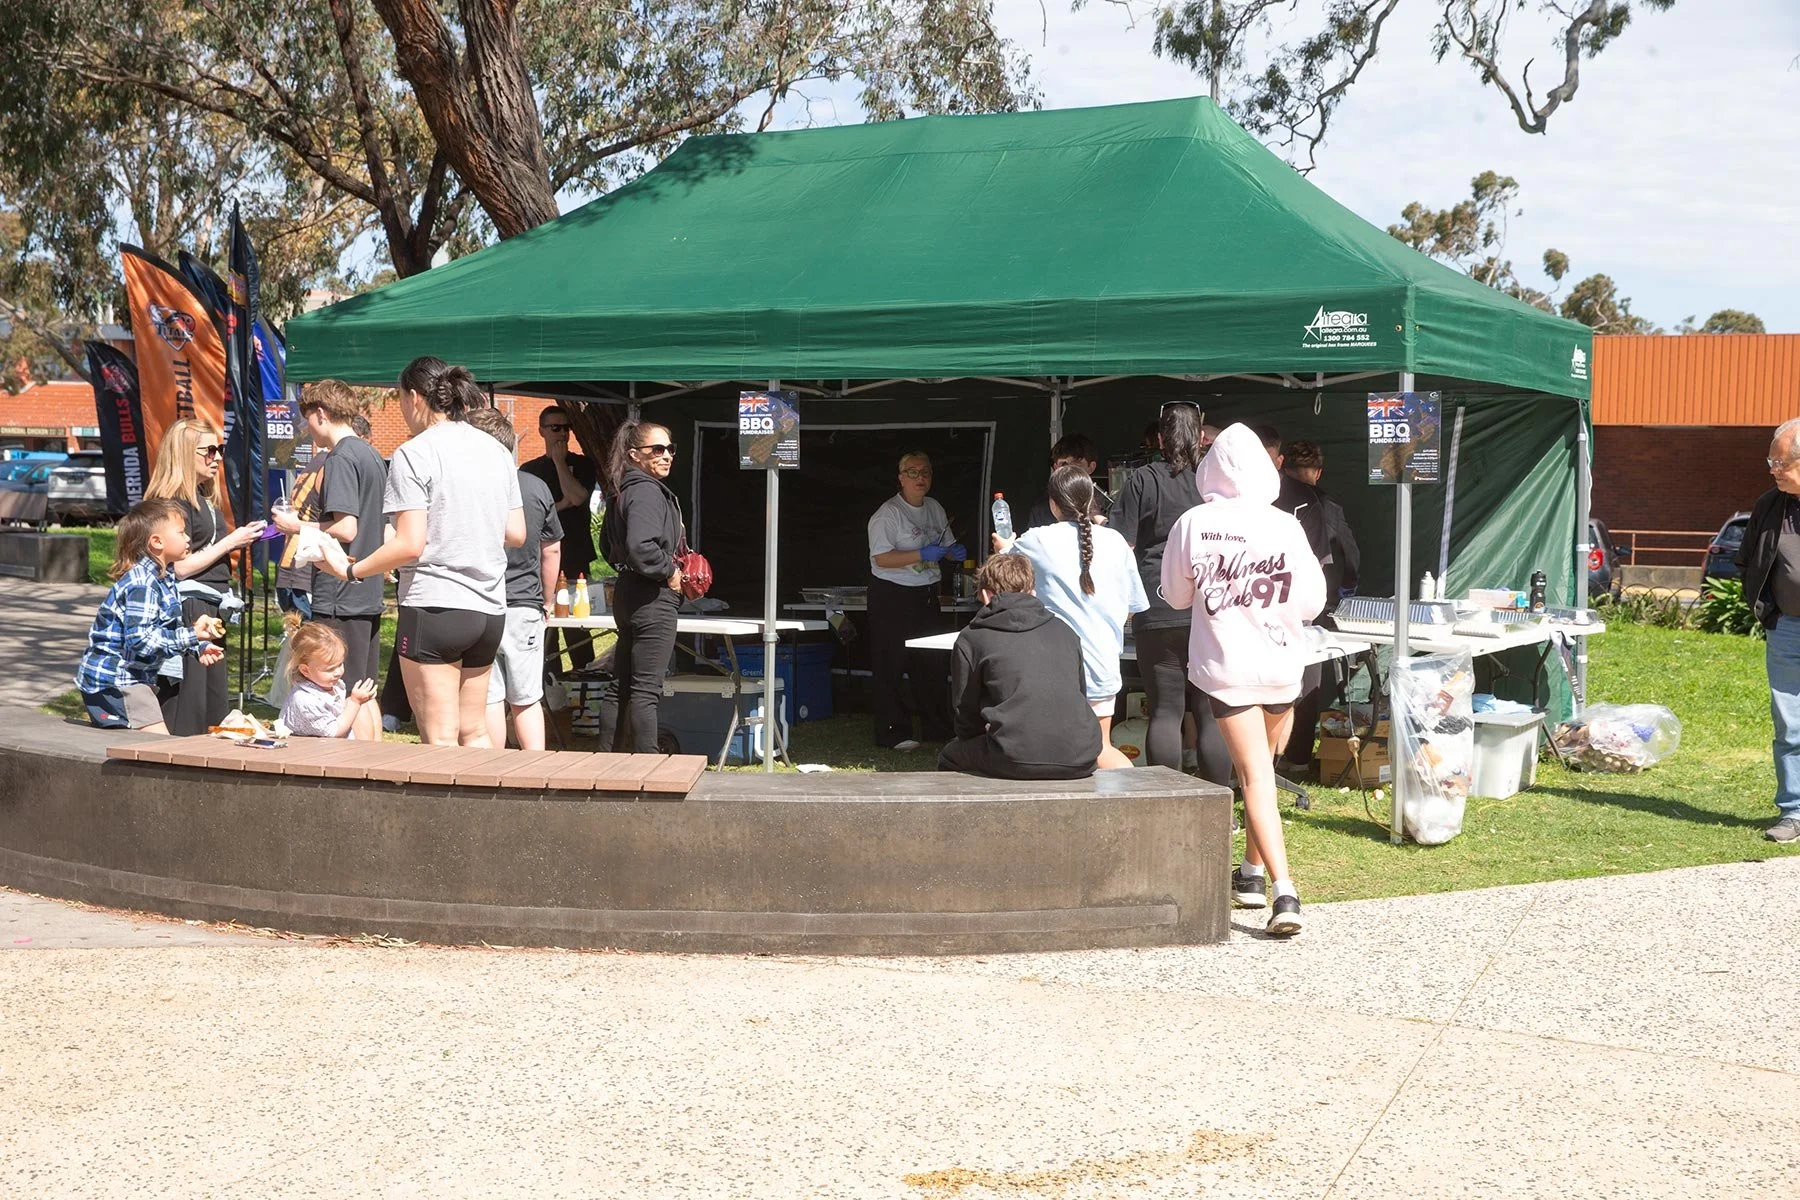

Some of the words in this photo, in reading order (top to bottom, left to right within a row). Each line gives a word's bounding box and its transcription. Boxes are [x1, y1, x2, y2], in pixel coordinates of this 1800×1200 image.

[172, 358, 197, 420] TBALL
[116, 398, 137, 443] BULLS
[268, 423, 294, 435] BBQ
[740, 417, 774, 430] BBQ
[1369, 423, 1410, 438] BBQ
[123, 447, 142, 506] MERNDA
[1201, 532, 1222, 541] With
[1225, 533, 1246, 543] love,
[1192, 551, 1285, 589] Wellness
[1204, 579, 1253, 616] Club
[1251, 571, 1292, 609] 97
